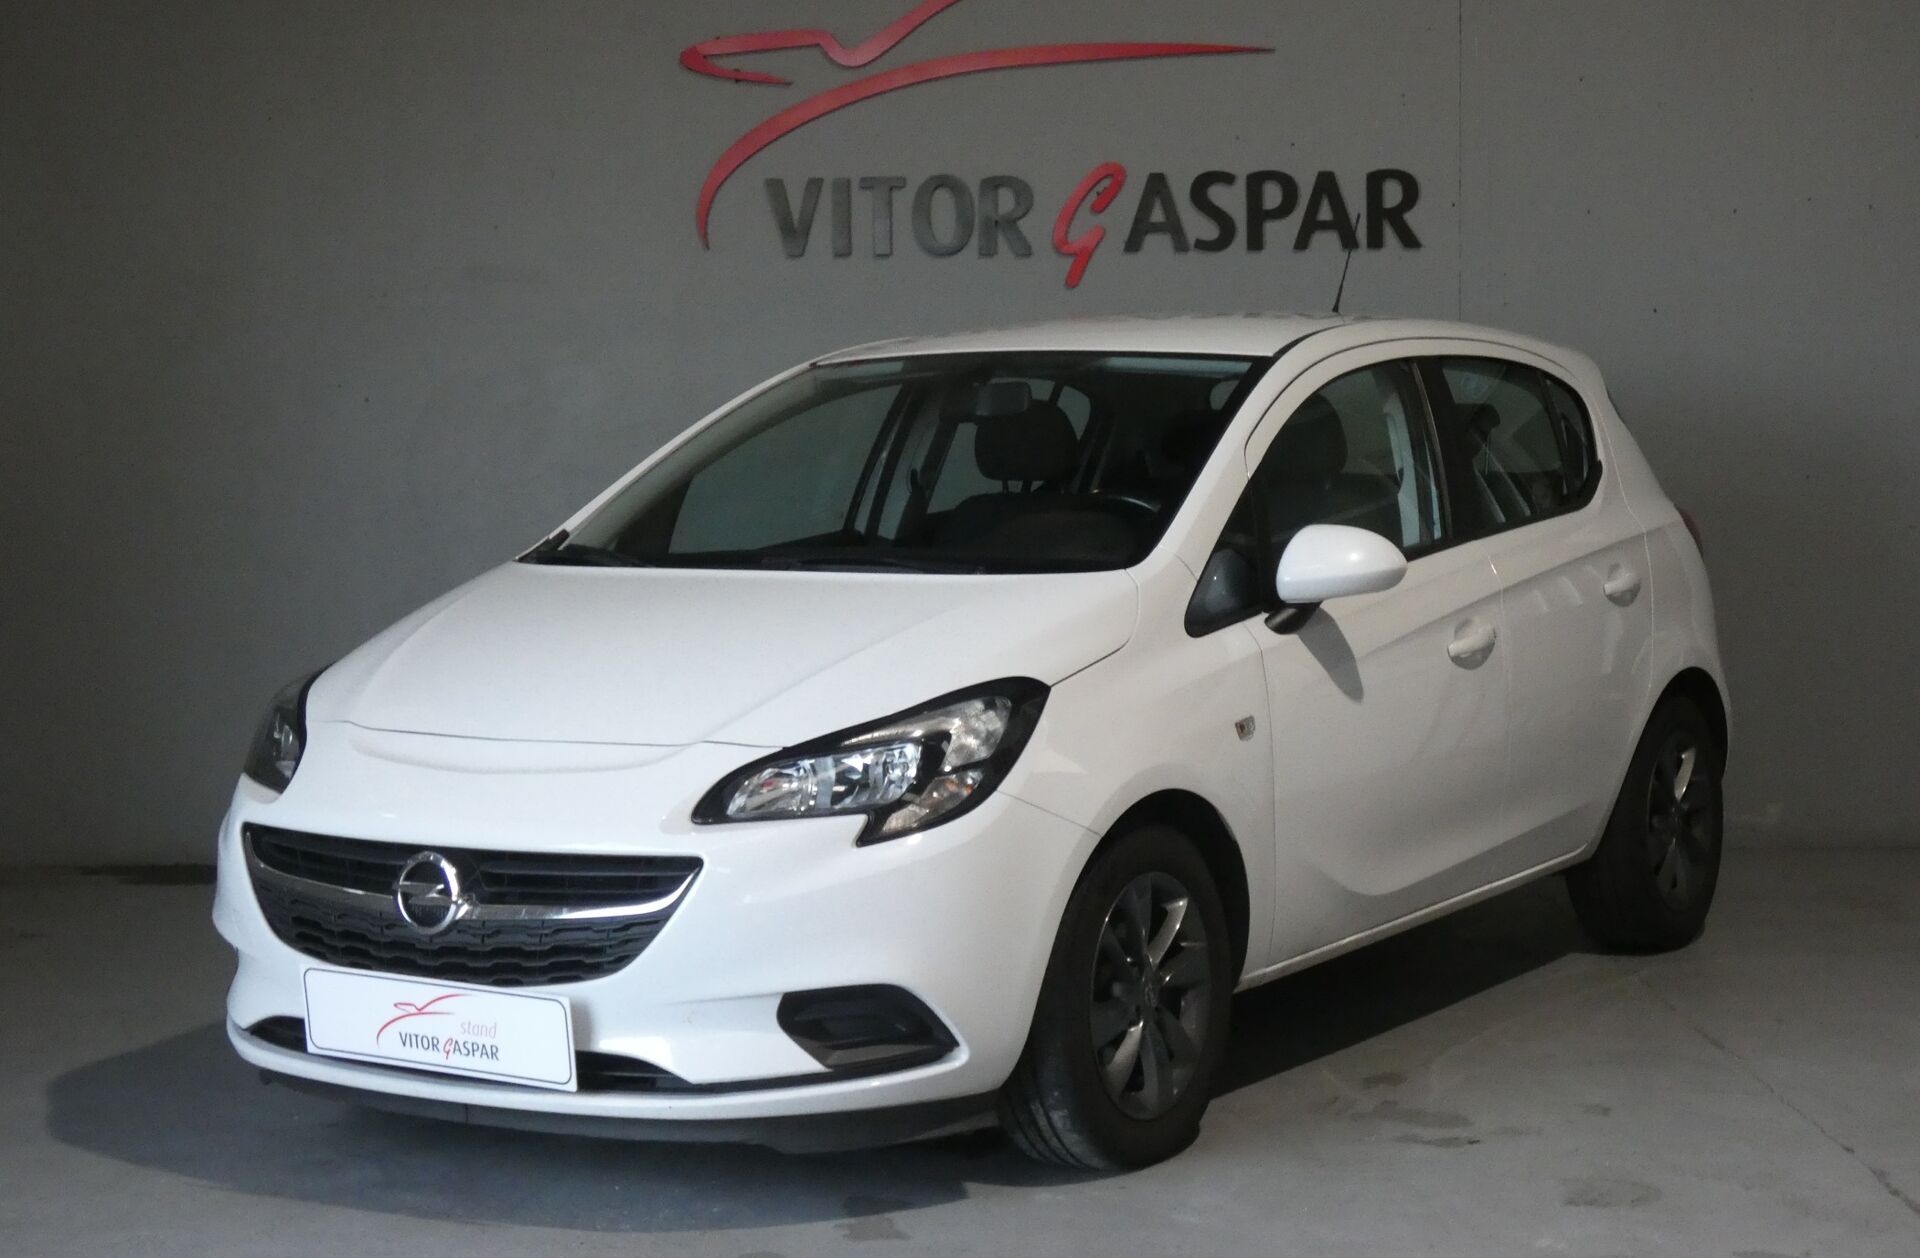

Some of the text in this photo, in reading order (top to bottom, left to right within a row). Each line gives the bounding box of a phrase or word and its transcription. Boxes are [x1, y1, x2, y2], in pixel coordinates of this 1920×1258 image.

[764, 161, 1424, 288] VITOR GASPAR
[460, 1019, 497, 1039] stand
[398, 1031, 500, 1061] VITOR GASPAR
